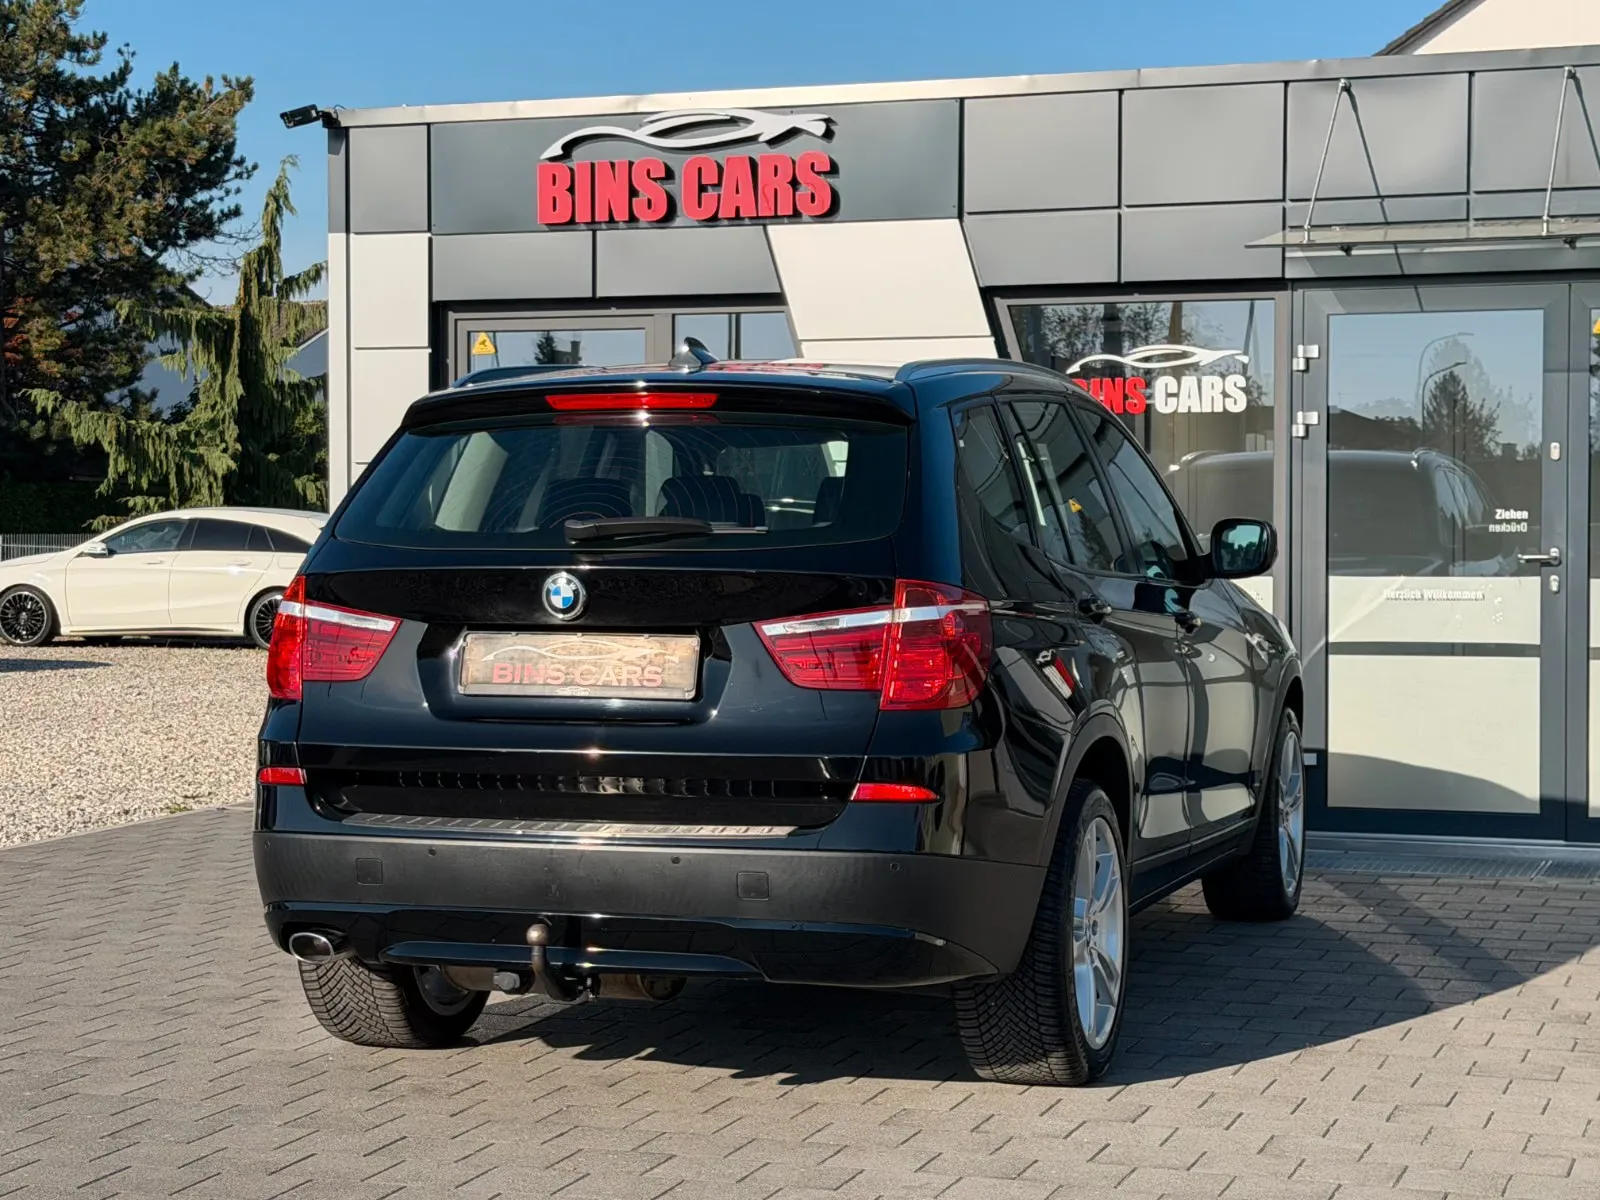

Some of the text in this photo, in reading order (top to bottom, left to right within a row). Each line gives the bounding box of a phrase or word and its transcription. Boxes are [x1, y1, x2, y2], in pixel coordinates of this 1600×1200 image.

[537, 151, 832, 225] BINS CARS
[1155, 374, 1248, 414] CARS
[1495, 508, 1528, 520] Ziehen
[1424, 588, 1484, 600] Willkommen
[492, 663, 663, 687] BINS CARS
